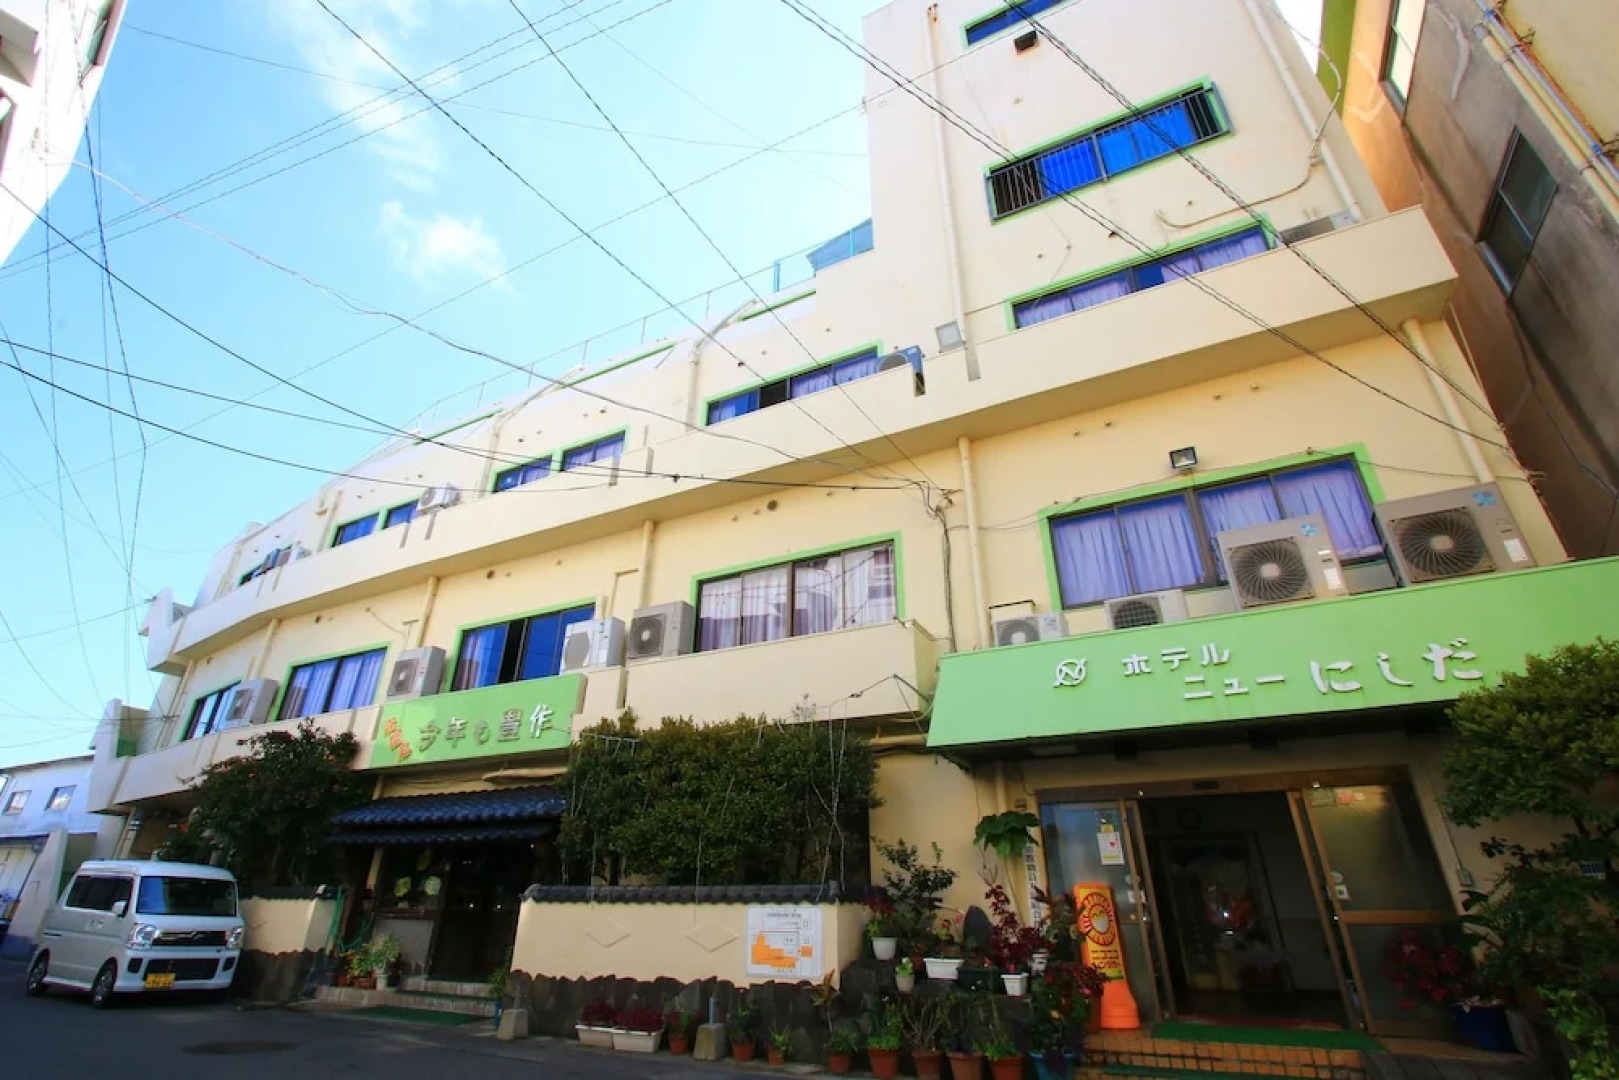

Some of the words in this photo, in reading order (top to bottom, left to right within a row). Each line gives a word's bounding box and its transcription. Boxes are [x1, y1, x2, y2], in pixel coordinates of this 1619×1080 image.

[1121, 643, 1231, 676] ホテル
[1183, 674, 1286, 700] ニュー
[1309, 637, 1484, 695] にしだ
